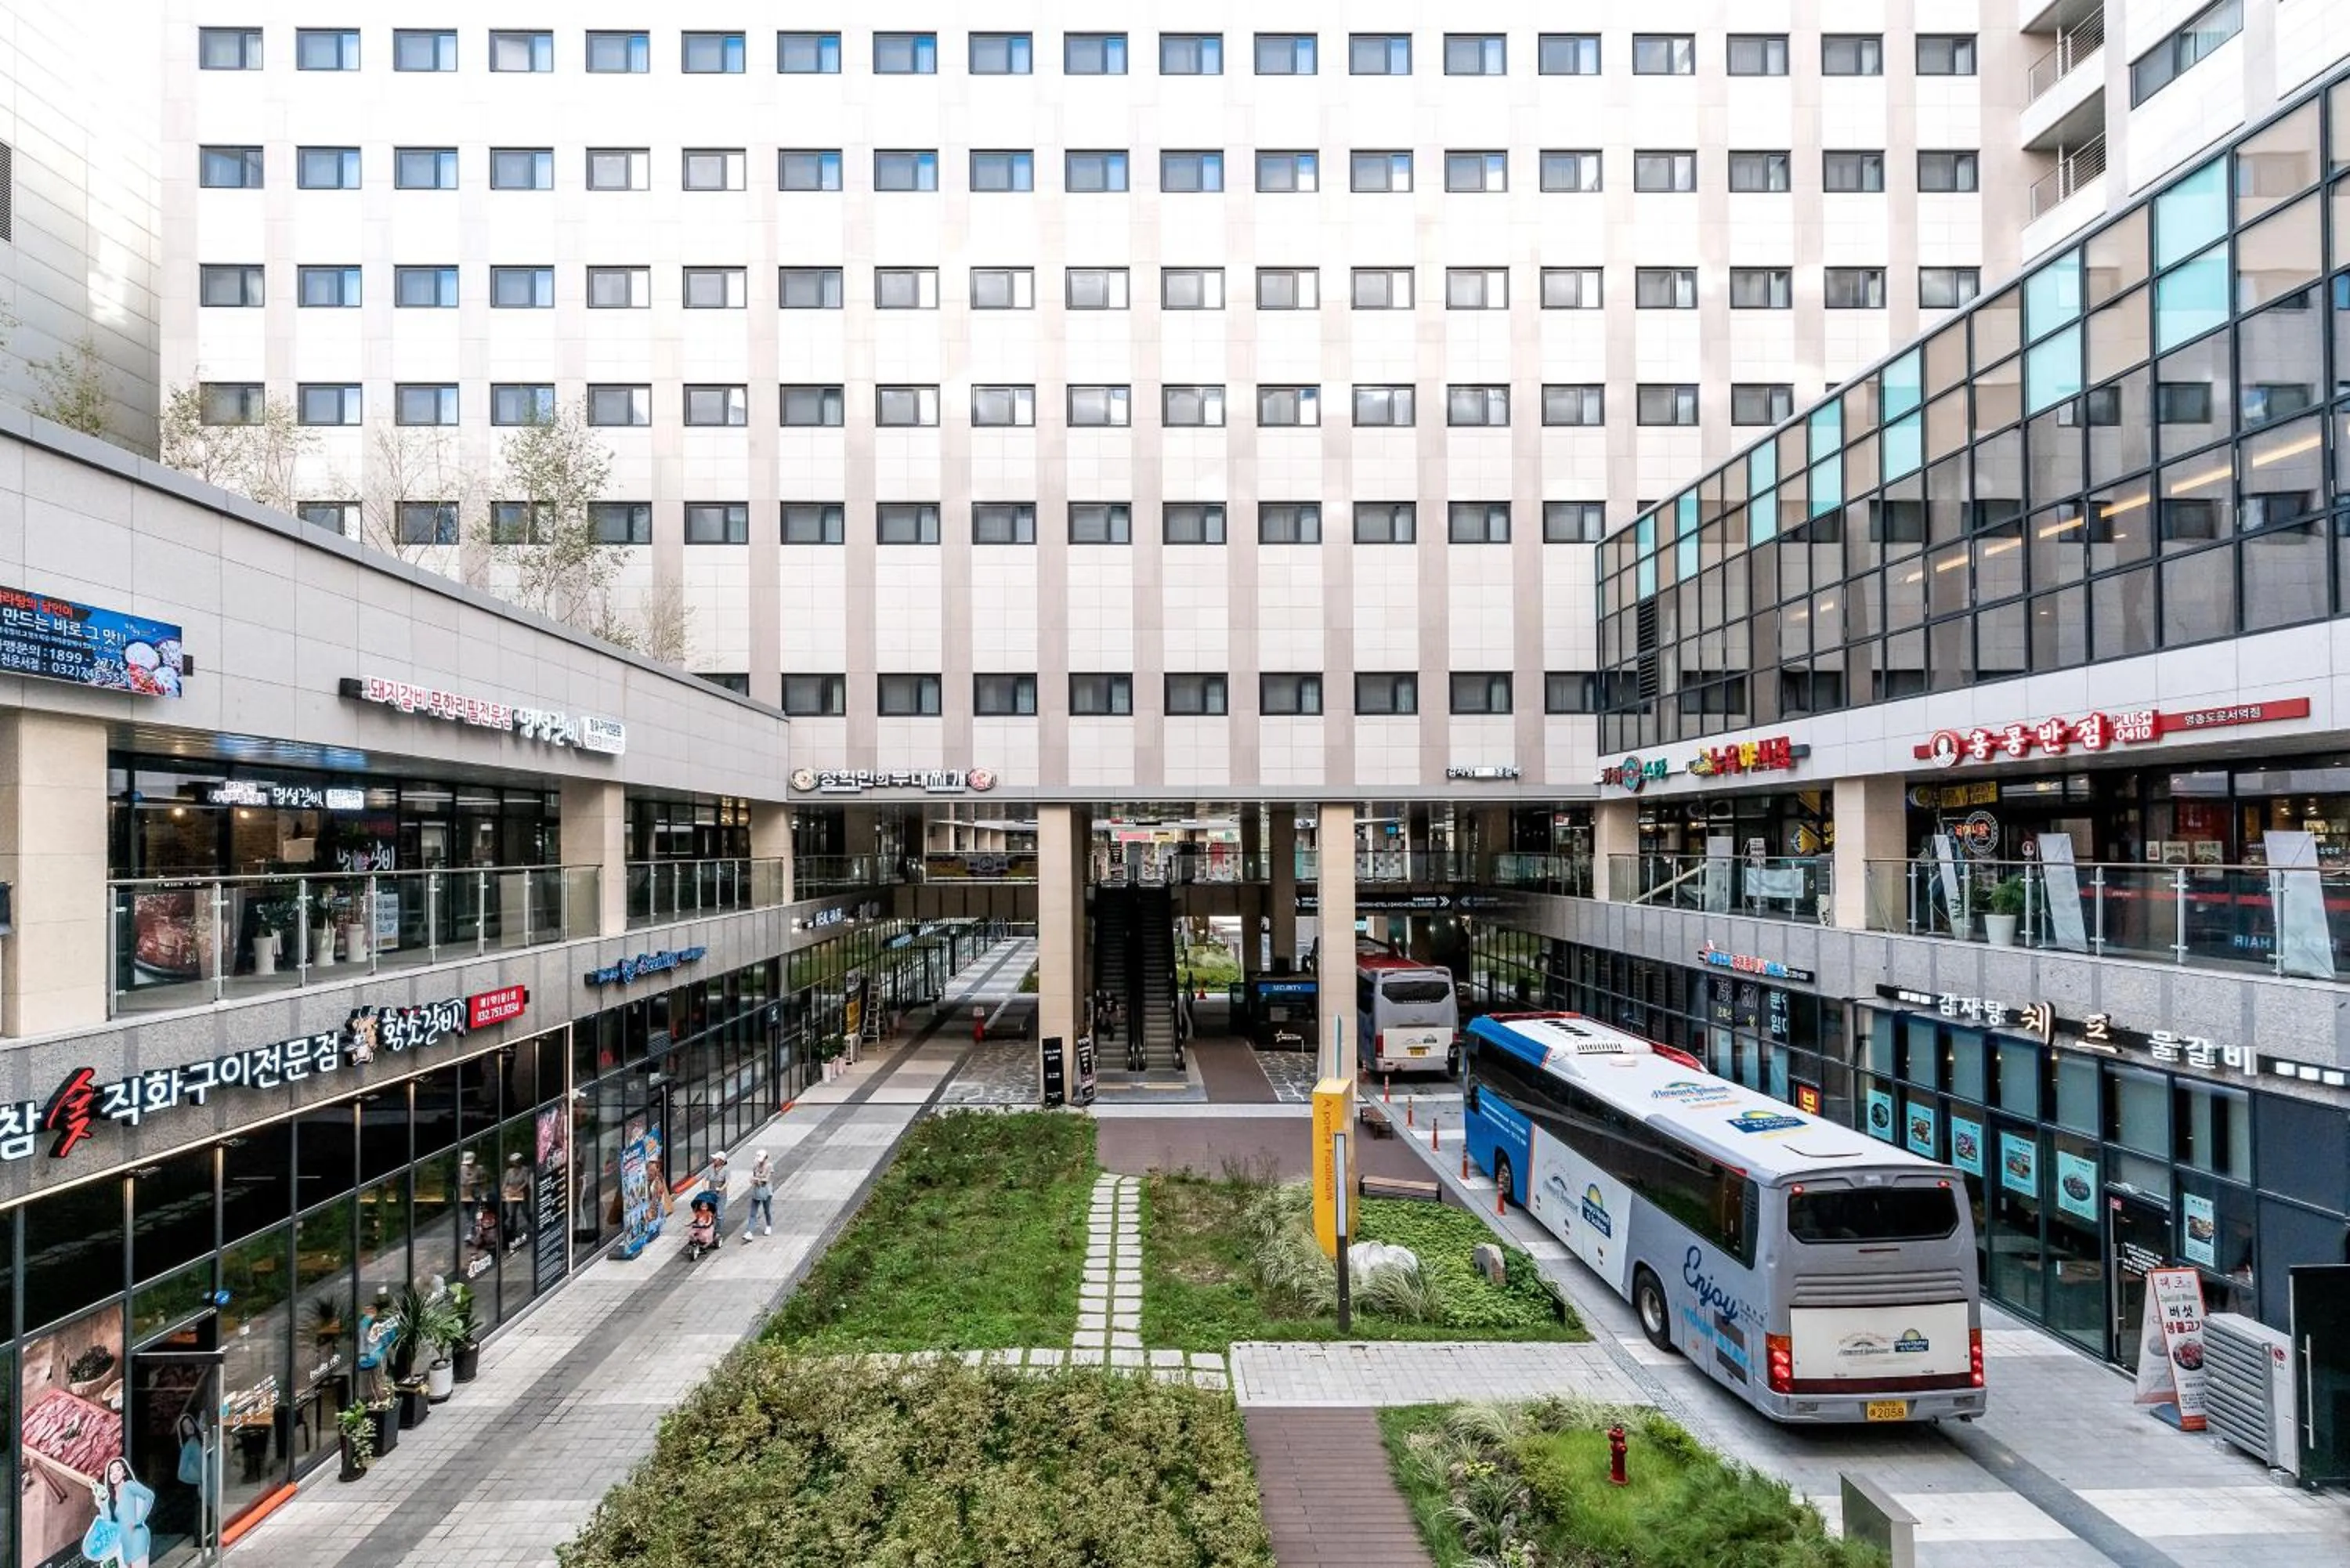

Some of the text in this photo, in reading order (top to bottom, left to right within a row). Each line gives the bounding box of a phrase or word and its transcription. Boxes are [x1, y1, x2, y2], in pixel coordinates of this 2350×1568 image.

[2, 608, 49, 632] 만드는
[371, 678, 426, 712] 돼지갈비
[431, 690, 512, 729] 무한리필전문점
[1968, 713, 2102, 759] 홍콩반점
[2115, 726, 2151, 741] 0410
[273, 786, 324, 807] 명성갈비
[381, 999, 465, 1052] 황소갈비
[1938, 992, 2008, 1025] 감자탕
[2147, 1029, 2258, 1075] 물갈비
[101, 1030, 339, 1125] 직화구이전문점
[1683, 1245, 1738, 1325] Enjoy
[2168, 1304, 2193, 1318] 버섯
